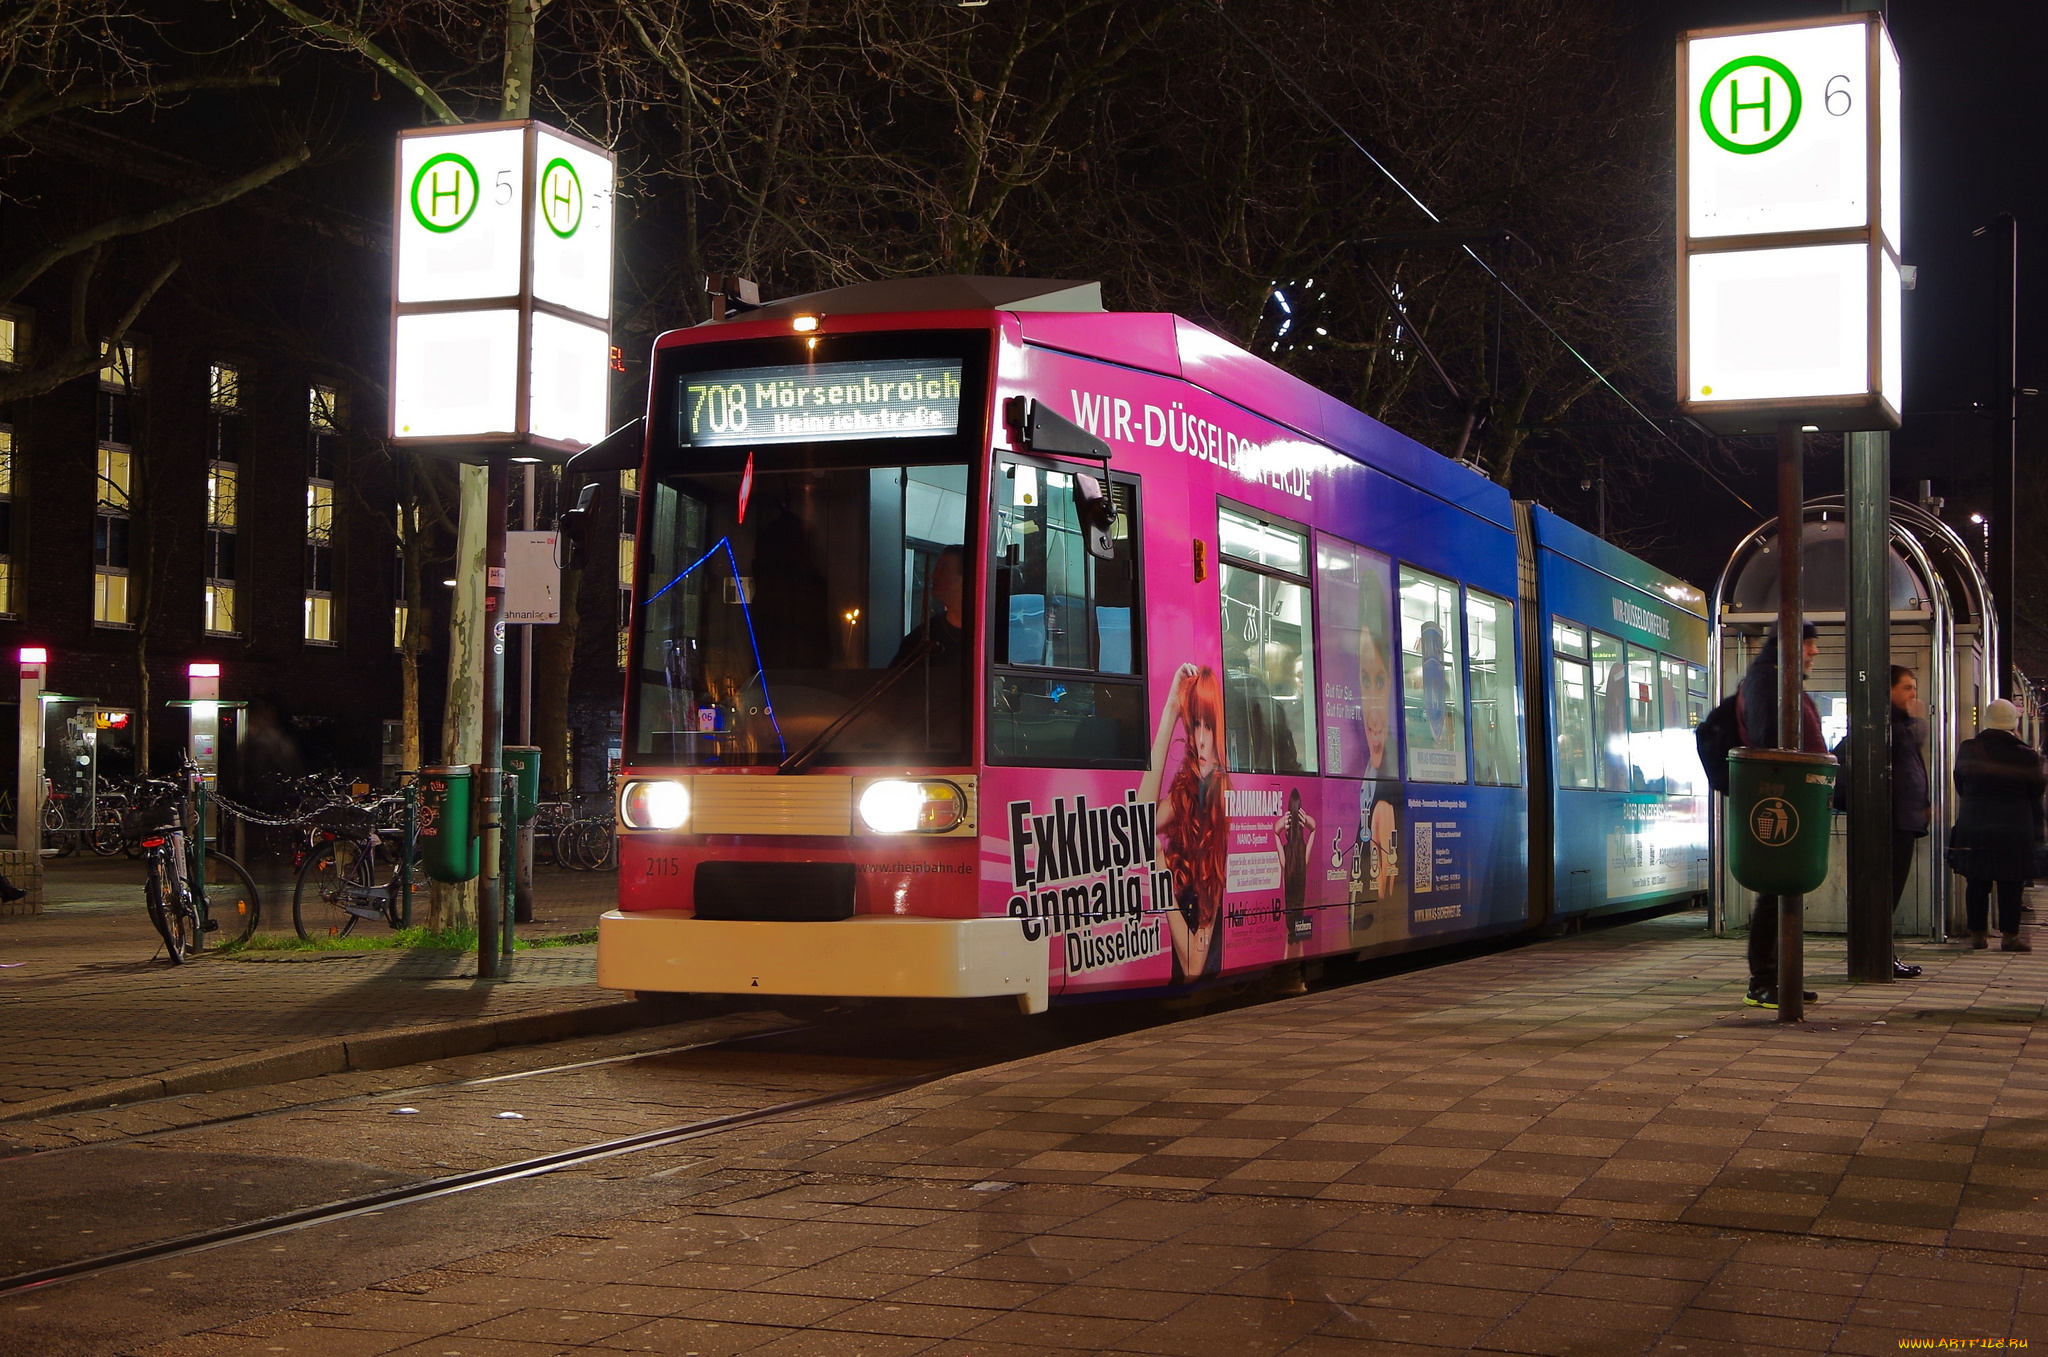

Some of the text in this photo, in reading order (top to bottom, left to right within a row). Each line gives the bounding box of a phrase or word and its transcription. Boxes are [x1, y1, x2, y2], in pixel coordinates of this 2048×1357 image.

[1824, 74, 1852, 117] 6
[494, 170, 514, 206] 5
[688, 371, 961, 434] 708 Mörsenbroich
[773, 407, 944, 433] Heinrichstraße
[1858, 670, 1866, 682] 5
[701, 712, 713, 722] 06
[1224, 790, 1283, 817] TRAUMHAARE
[1011, 791, 1156, 887] Exklusiv
[646, 857, 680, 877] 2115
[856, 861, 972, 874] www.rheinbahn.de
[1009, 862, 1174, 940] einmalig in
[1067, 919, 1160, 974] Düsseldorf
